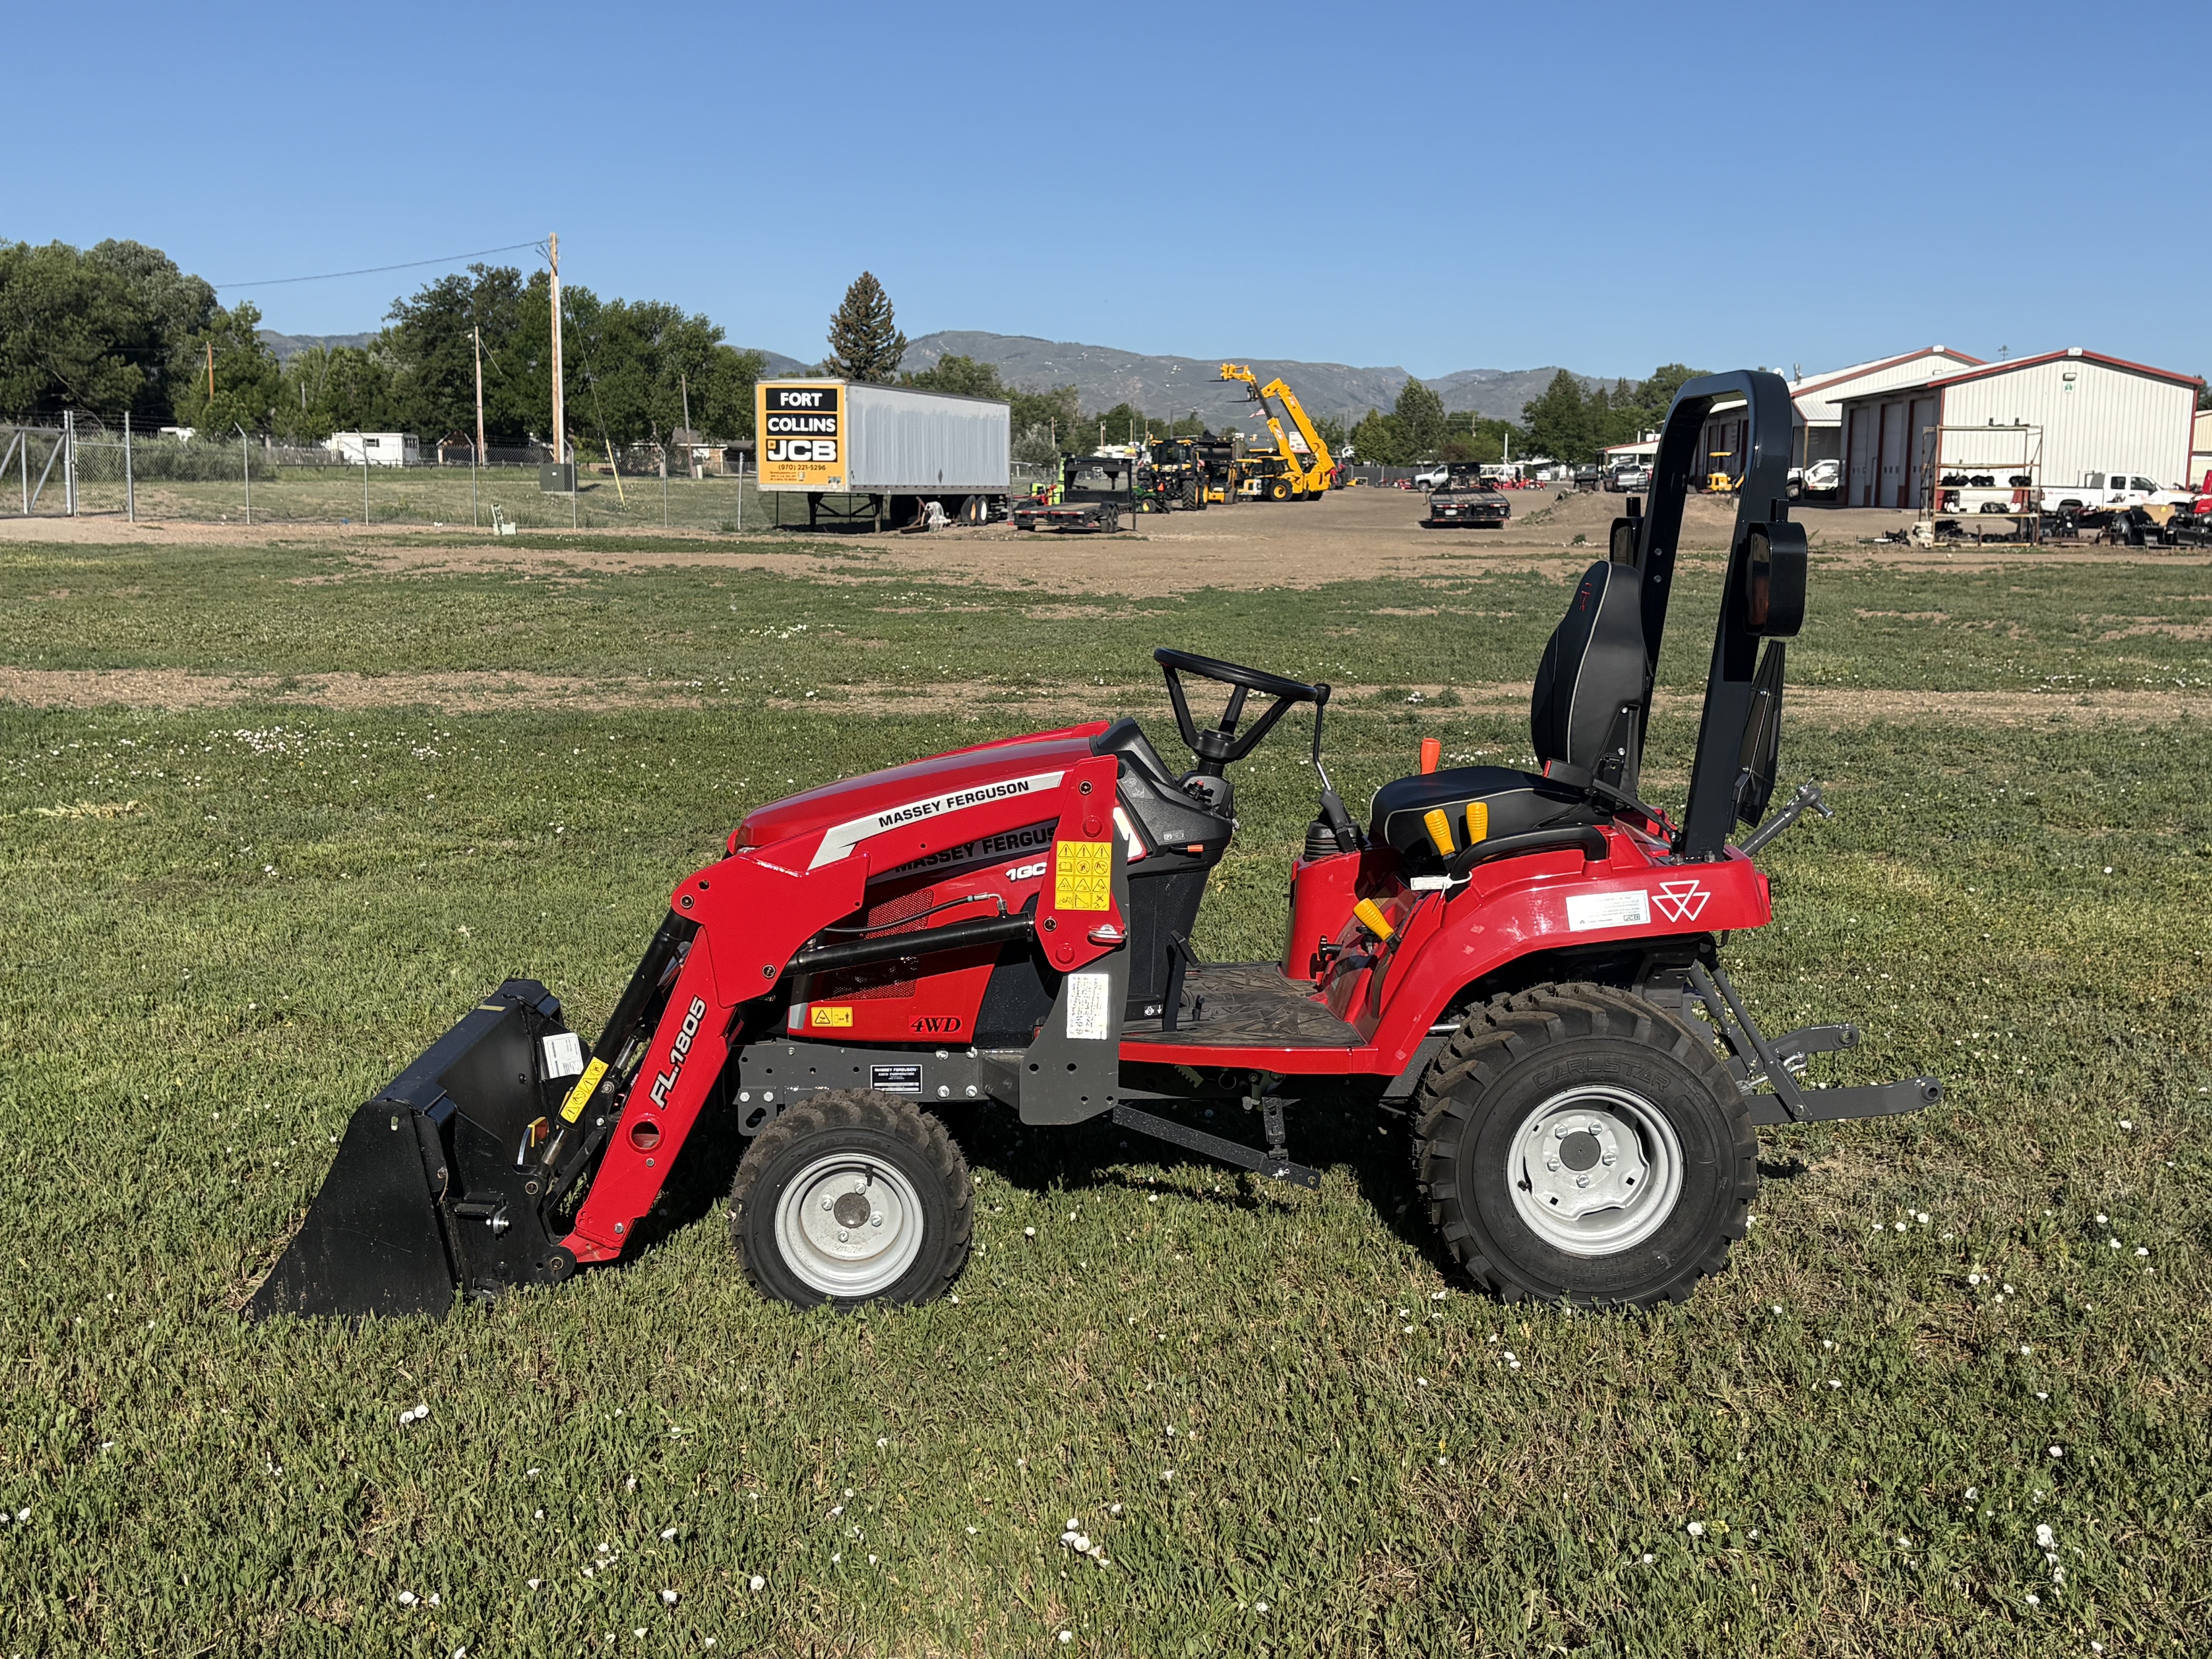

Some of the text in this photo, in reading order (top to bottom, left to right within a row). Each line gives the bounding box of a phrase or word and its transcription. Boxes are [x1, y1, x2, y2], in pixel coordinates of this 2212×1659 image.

[780, 392, 823, 407] FORT
[768, 417, 836, 432] COLLINS
[768, 440, 836, 461] JCB
[878, 781, 1030, 827] MASSEY FERGUSON
[910, 1016, 961, 1032] 4WD
[649, 995, 706, 1109] FL.1805
[1532, 1057, 1671, 1092] CARLSTAR
